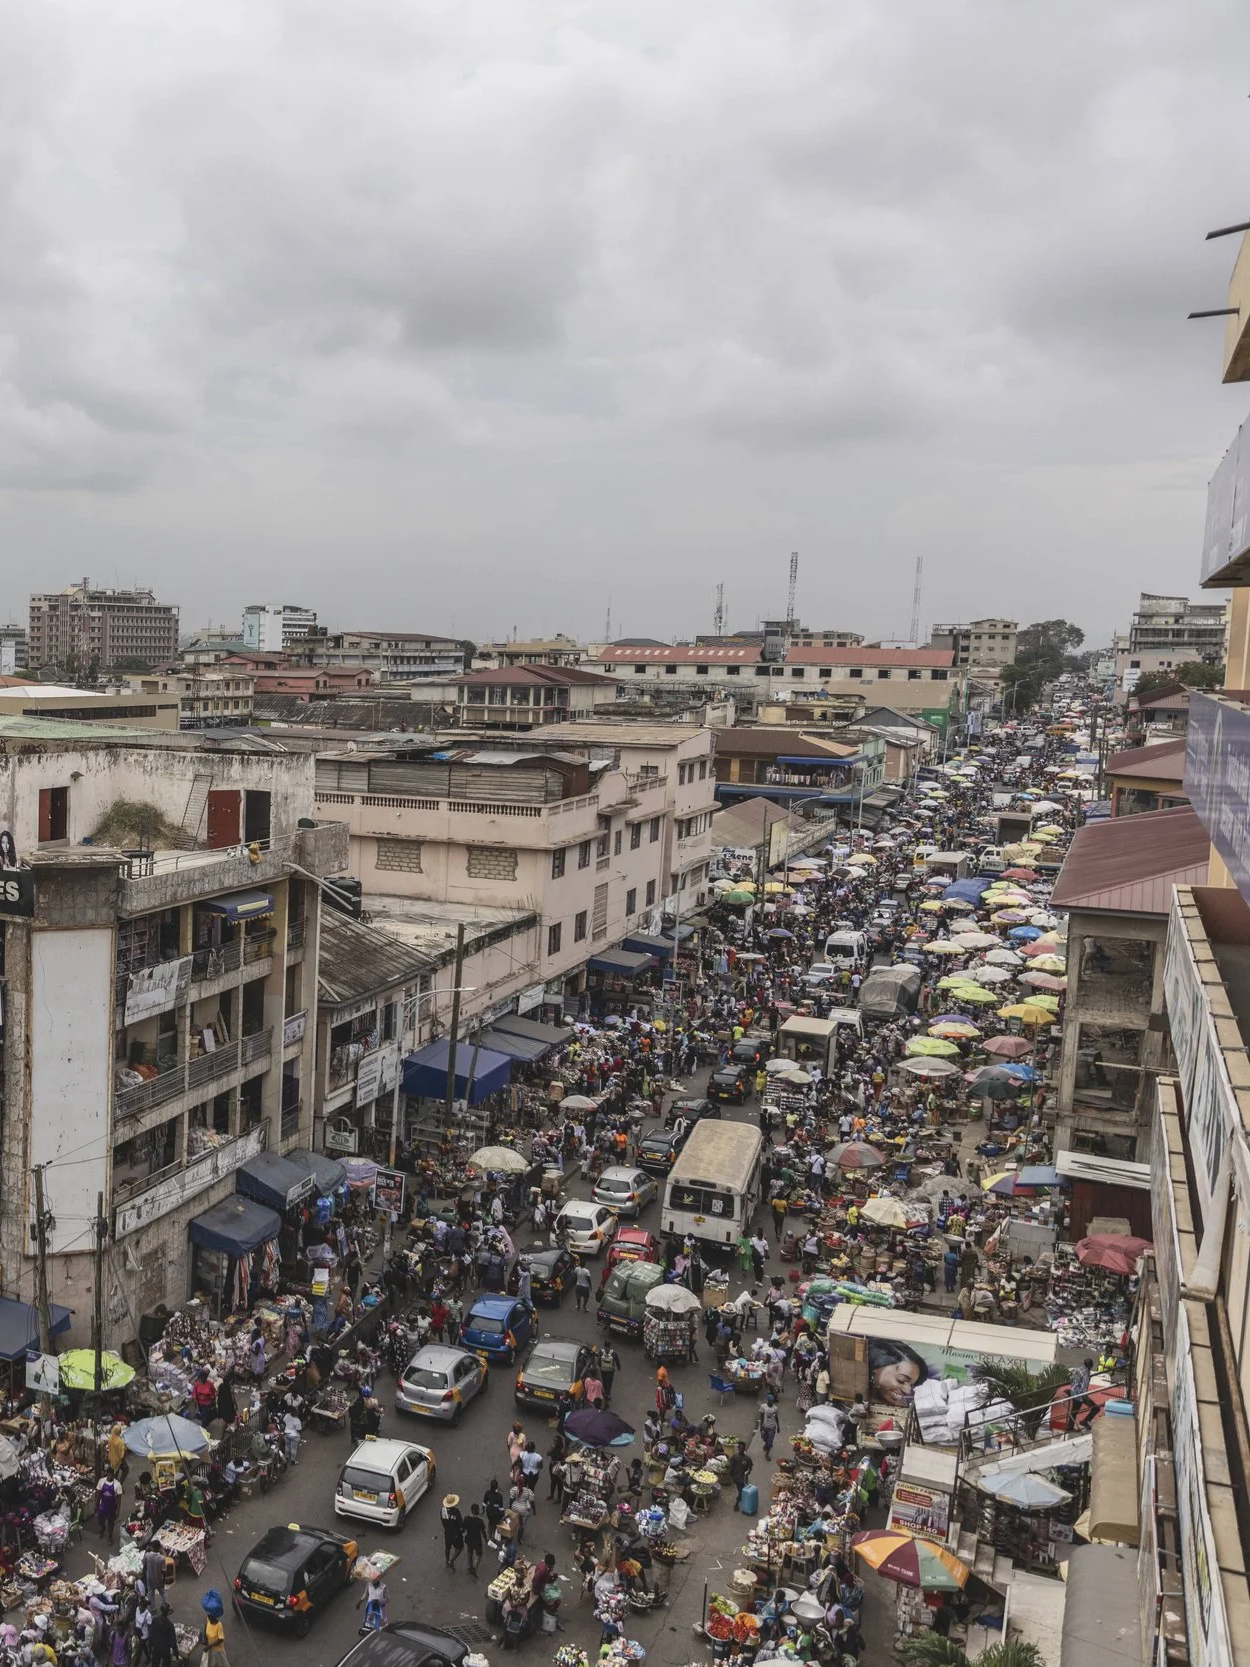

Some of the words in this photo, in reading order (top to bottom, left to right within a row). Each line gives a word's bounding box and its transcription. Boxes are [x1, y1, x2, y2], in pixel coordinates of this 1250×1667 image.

[941, 1348, 974, 1360] Maxim
[899, 1519, 922, 1529] SHOP
[923, 1525, 938, 1534] 140
